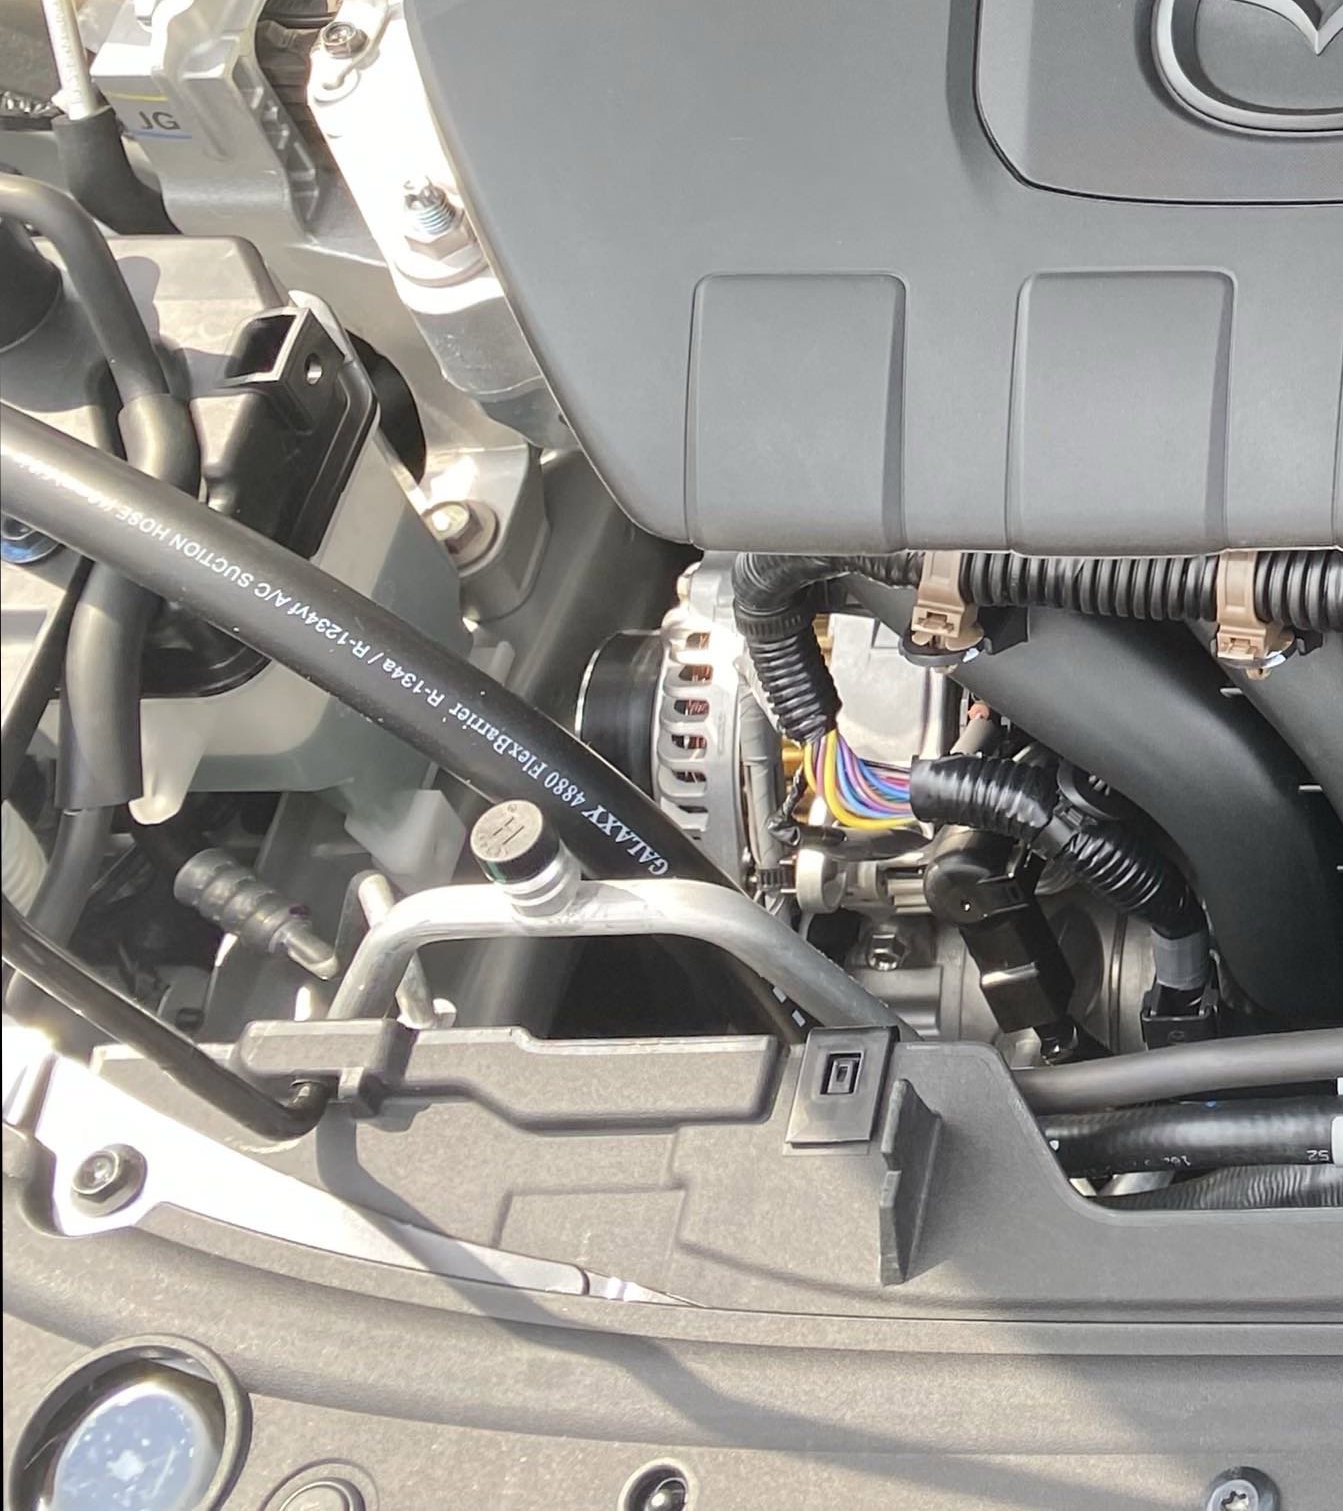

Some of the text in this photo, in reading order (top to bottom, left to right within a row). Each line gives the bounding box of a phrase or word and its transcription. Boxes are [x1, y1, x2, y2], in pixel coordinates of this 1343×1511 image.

[116, 505, 171, 541] HOSE
[169, 536, 254, 588] SUCTION
[254, 581, 292, 608] A/C
[287, 603, 371, 659] R-1234yf
[382, 658, 445, 707] R-134a
[449, 702, 549, 779] FlexBarrier
[544, 771, 586, 807] 4880
[581, 804, 669, 876] GALAXY
